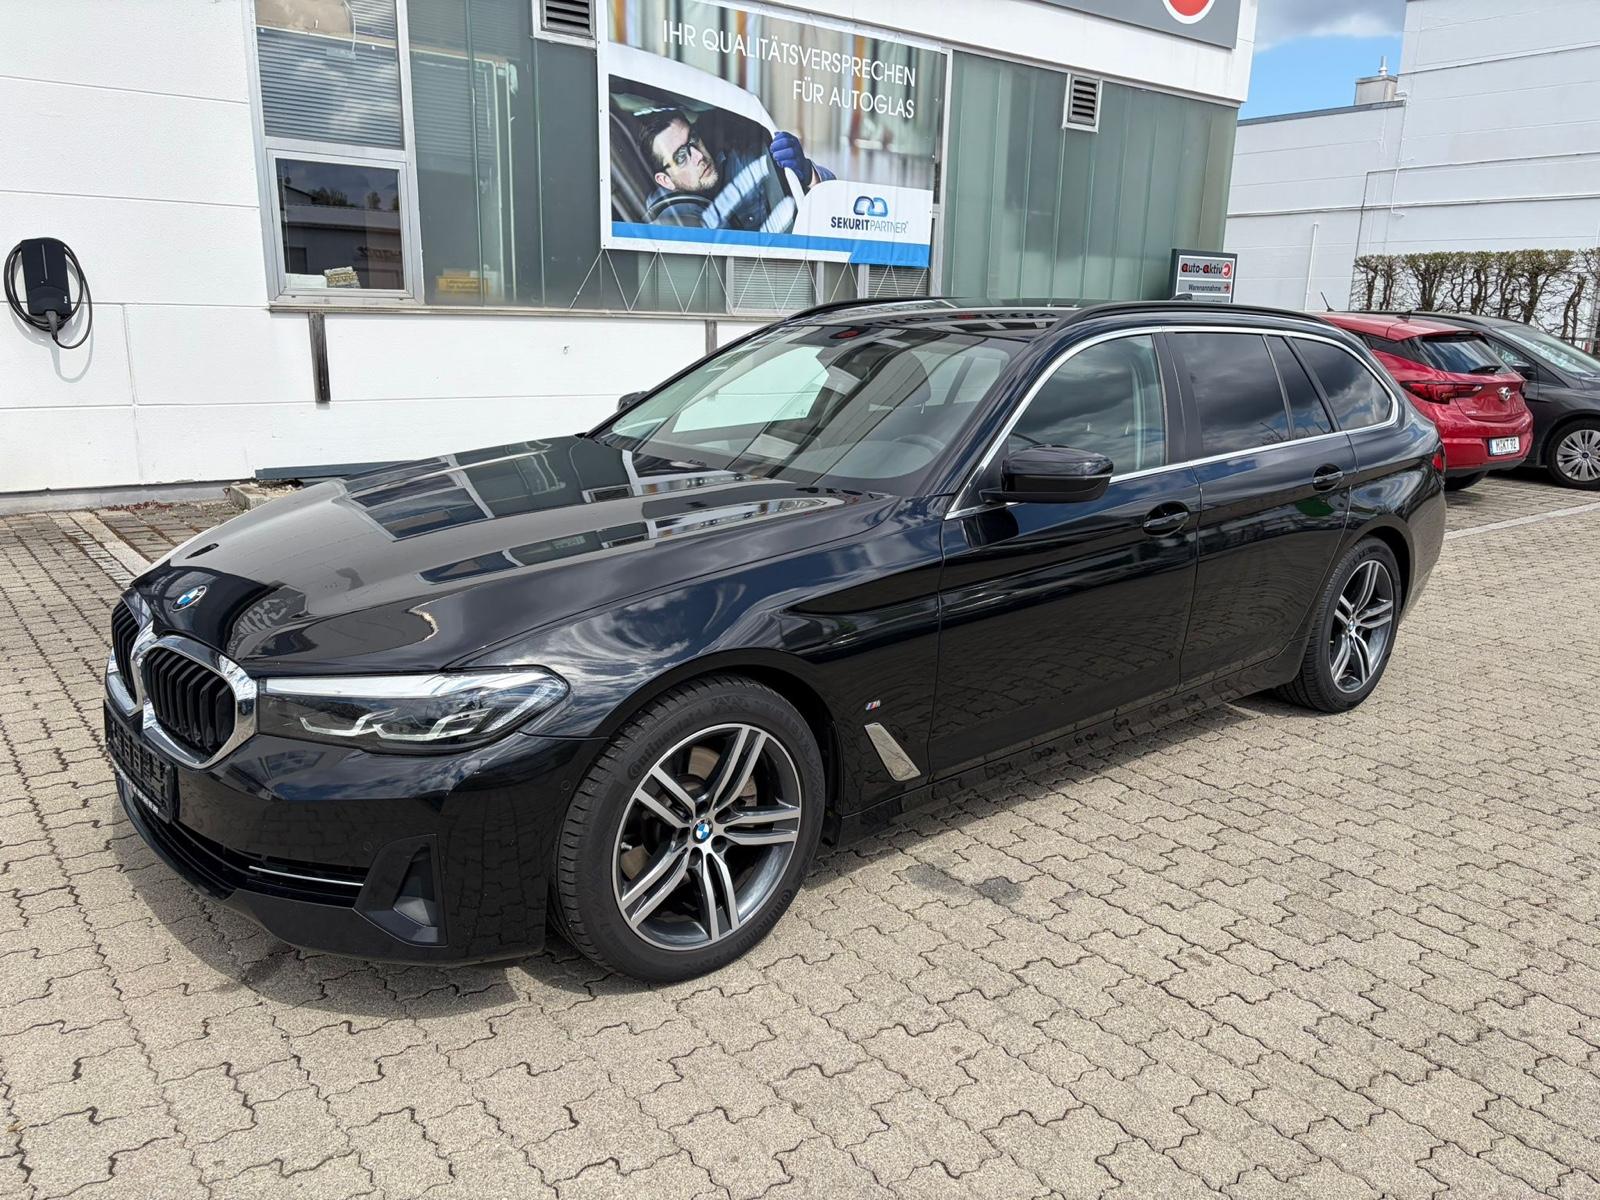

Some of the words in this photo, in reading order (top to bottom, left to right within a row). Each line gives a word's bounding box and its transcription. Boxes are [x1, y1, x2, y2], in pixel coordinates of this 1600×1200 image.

[663, 20, 696, 47] IHR
[702, 28, 916, 88] QUALITÄTSVERSPRECHEN
[793, 79, 823, 105] FÜR
[829, 87, 914, 119] AUTOGLAS
